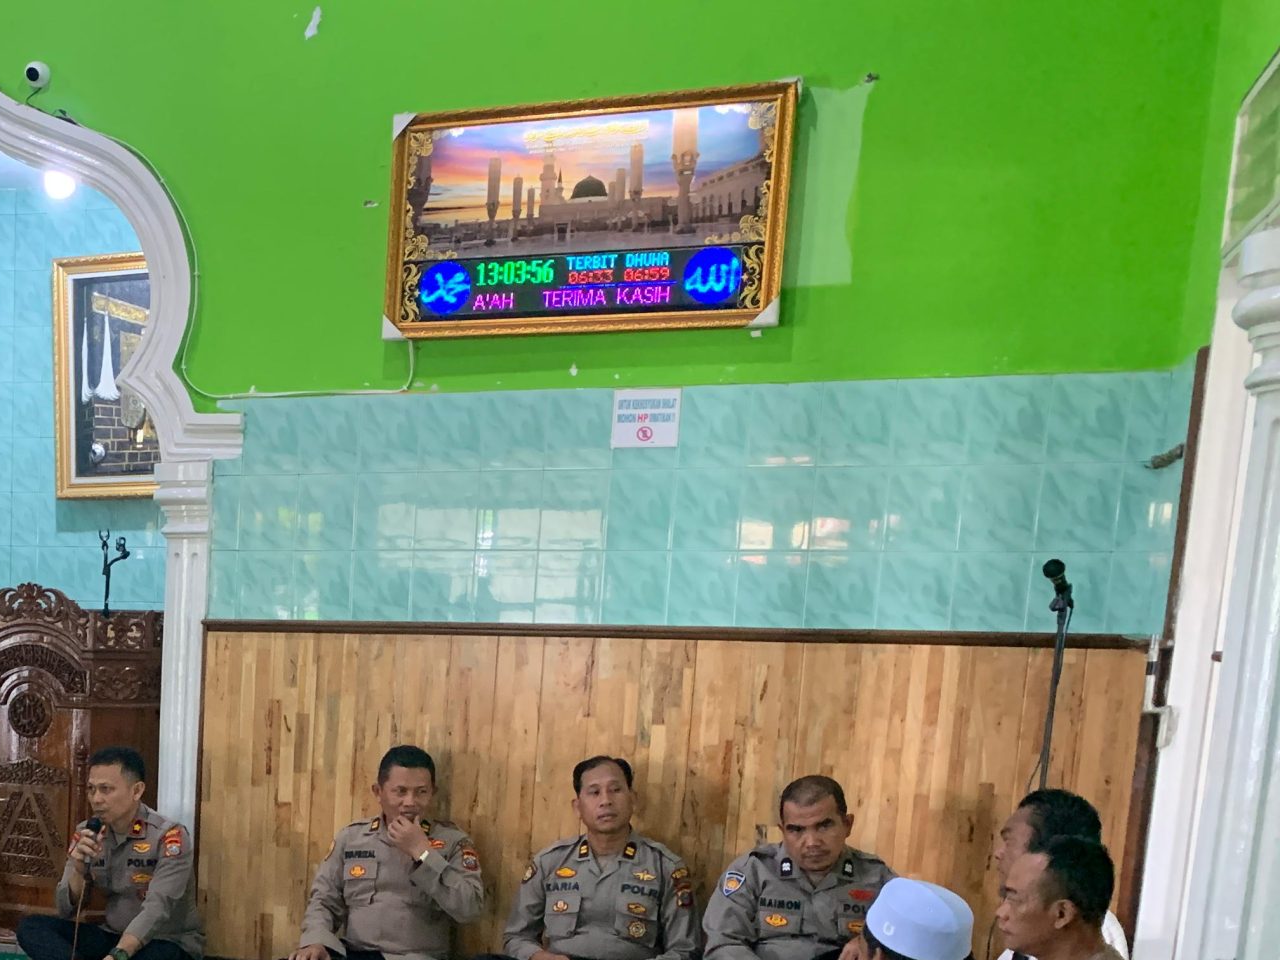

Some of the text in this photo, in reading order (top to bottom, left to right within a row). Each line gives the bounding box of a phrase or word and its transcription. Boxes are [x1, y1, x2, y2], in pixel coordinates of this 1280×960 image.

[566, 251, 670, 270] TERBIT DHUHA
[476, 259, 555, 286] 13:03:56
[543, 289, 607, 308] TERIMA
[616, 286, 671, 305] KASIH
[637, 412, 649, 423] HP
[621, 883, 658, 897] POLR
